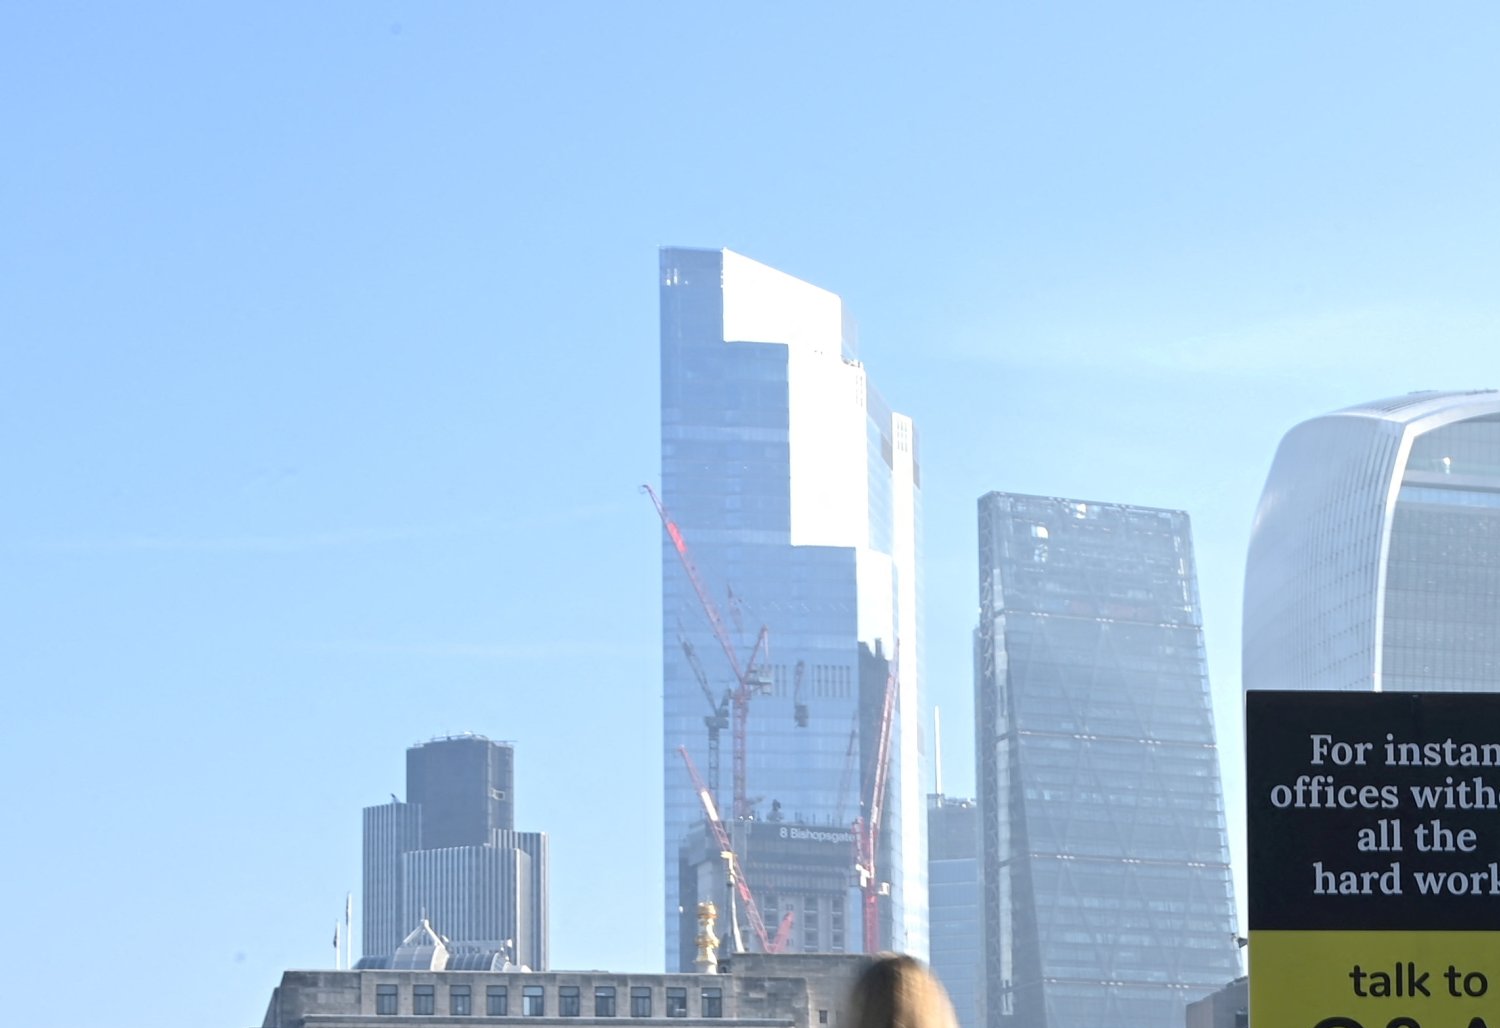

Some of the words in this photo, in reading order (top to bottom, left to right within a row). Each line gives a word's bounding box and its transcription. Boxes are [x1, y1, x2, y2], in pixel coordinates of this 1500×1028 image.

[1310, 735, 1374, 766] For
[1270, 776, 1399, 809] offices
[780, 827, 788, 838] 8
[790, 828, 855, 843] Bishopsgate
[1357, 819, 1403, 851] all
[1415, 820, 1477, 851] the
[1312, 862, 1403, 894] hard
[1349, 962, 1431, 997] talk
[1444, 964, 1488, 997] to
